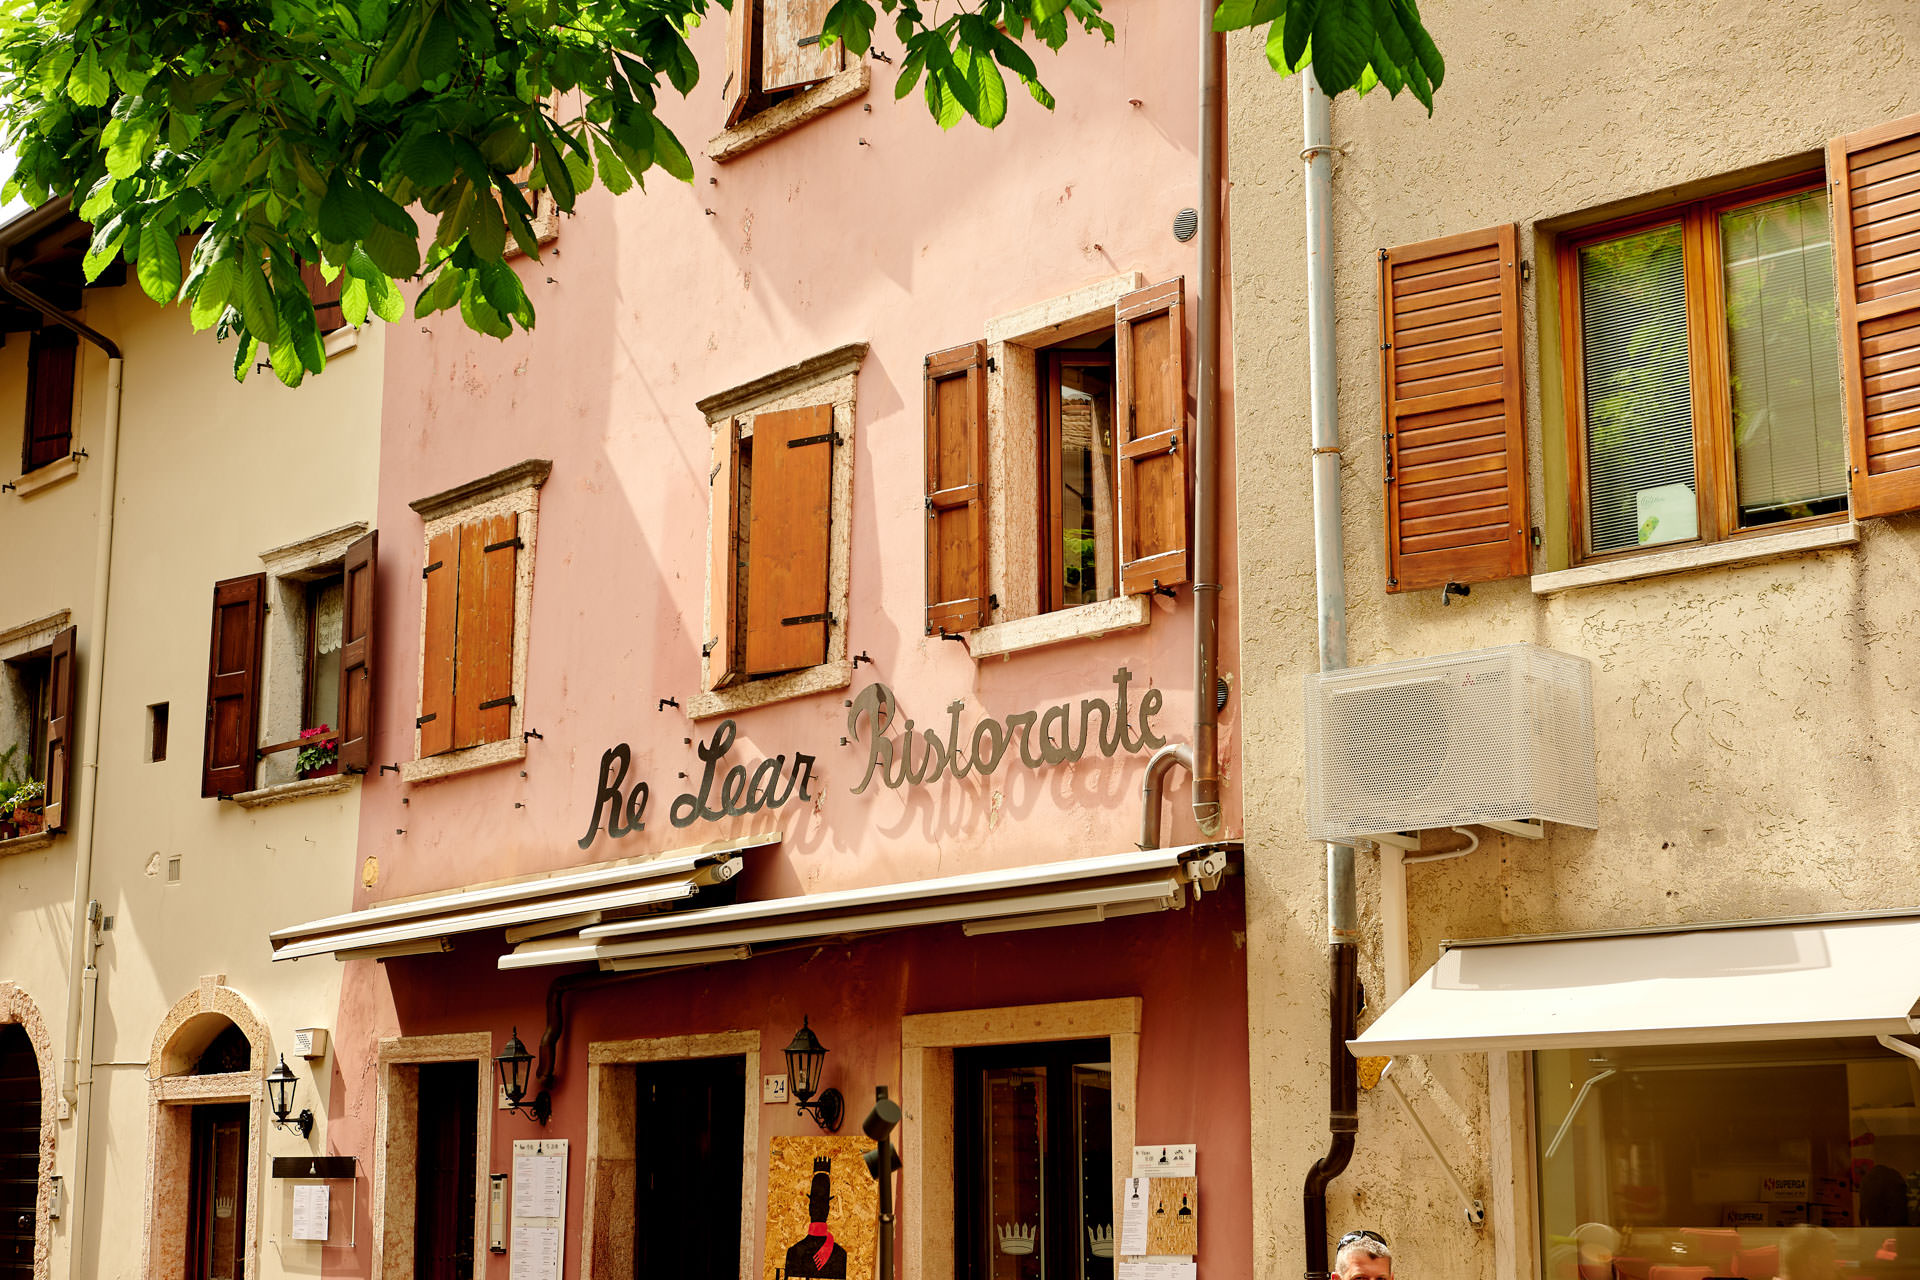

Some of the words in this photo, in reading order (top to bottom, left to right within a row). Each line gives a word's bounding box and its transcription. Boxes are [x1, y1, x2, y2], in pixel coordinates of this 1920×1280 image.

[578, 742, 649, 850] Re
[670, 719, 816, 828] Lear
[848, 667, 1167, 794] Ristorante
[773, 1080, 785, 1094] 24
[1775, 1179, 1806, 1190] SUPERGA
